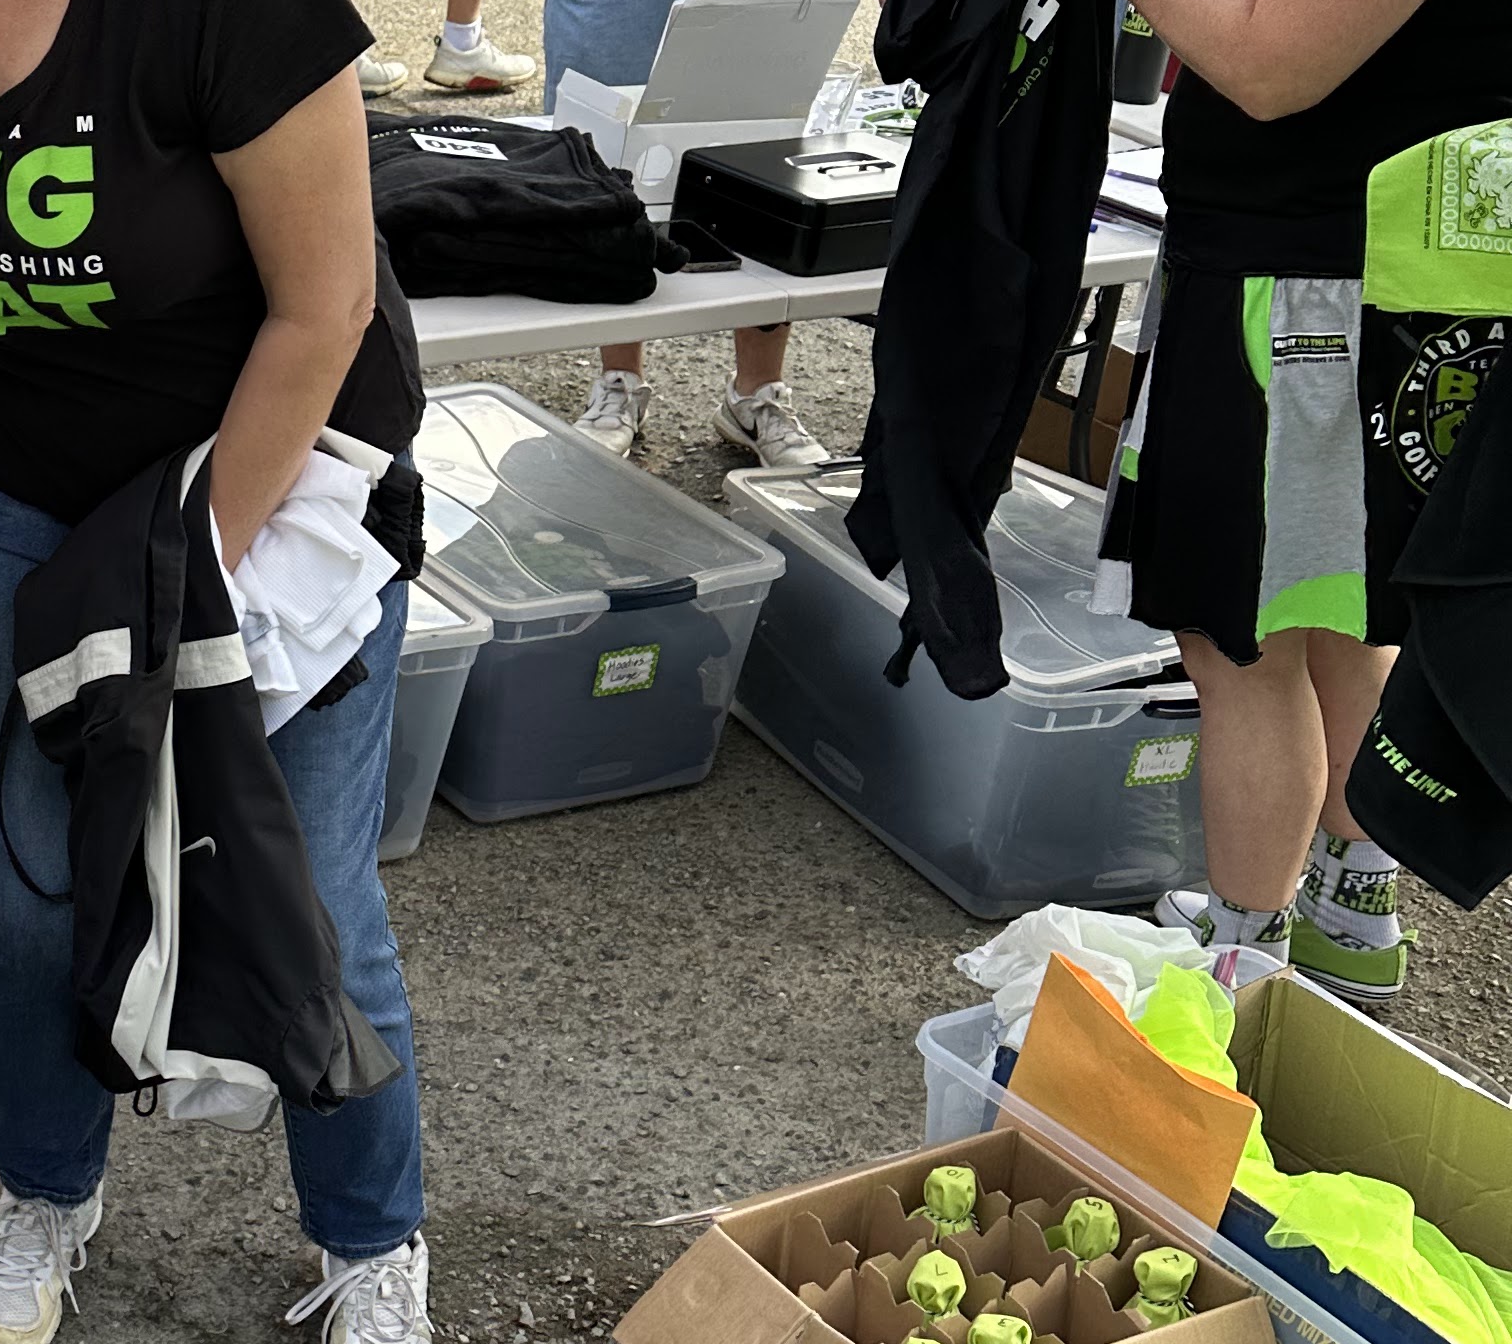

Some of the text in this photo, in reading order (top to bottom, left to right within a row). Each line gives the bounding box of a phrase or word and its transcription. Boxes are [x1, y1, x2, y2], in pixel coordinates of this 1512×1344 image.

[1017, 67, 1041, 97] cure
[425, 140, 494, 154] $40
[1408, 329, 1471, 392] THIRD
[1399, 431, 1439, 483] GOLF
[1375, 734, 1458, 803] THE LIMIT
